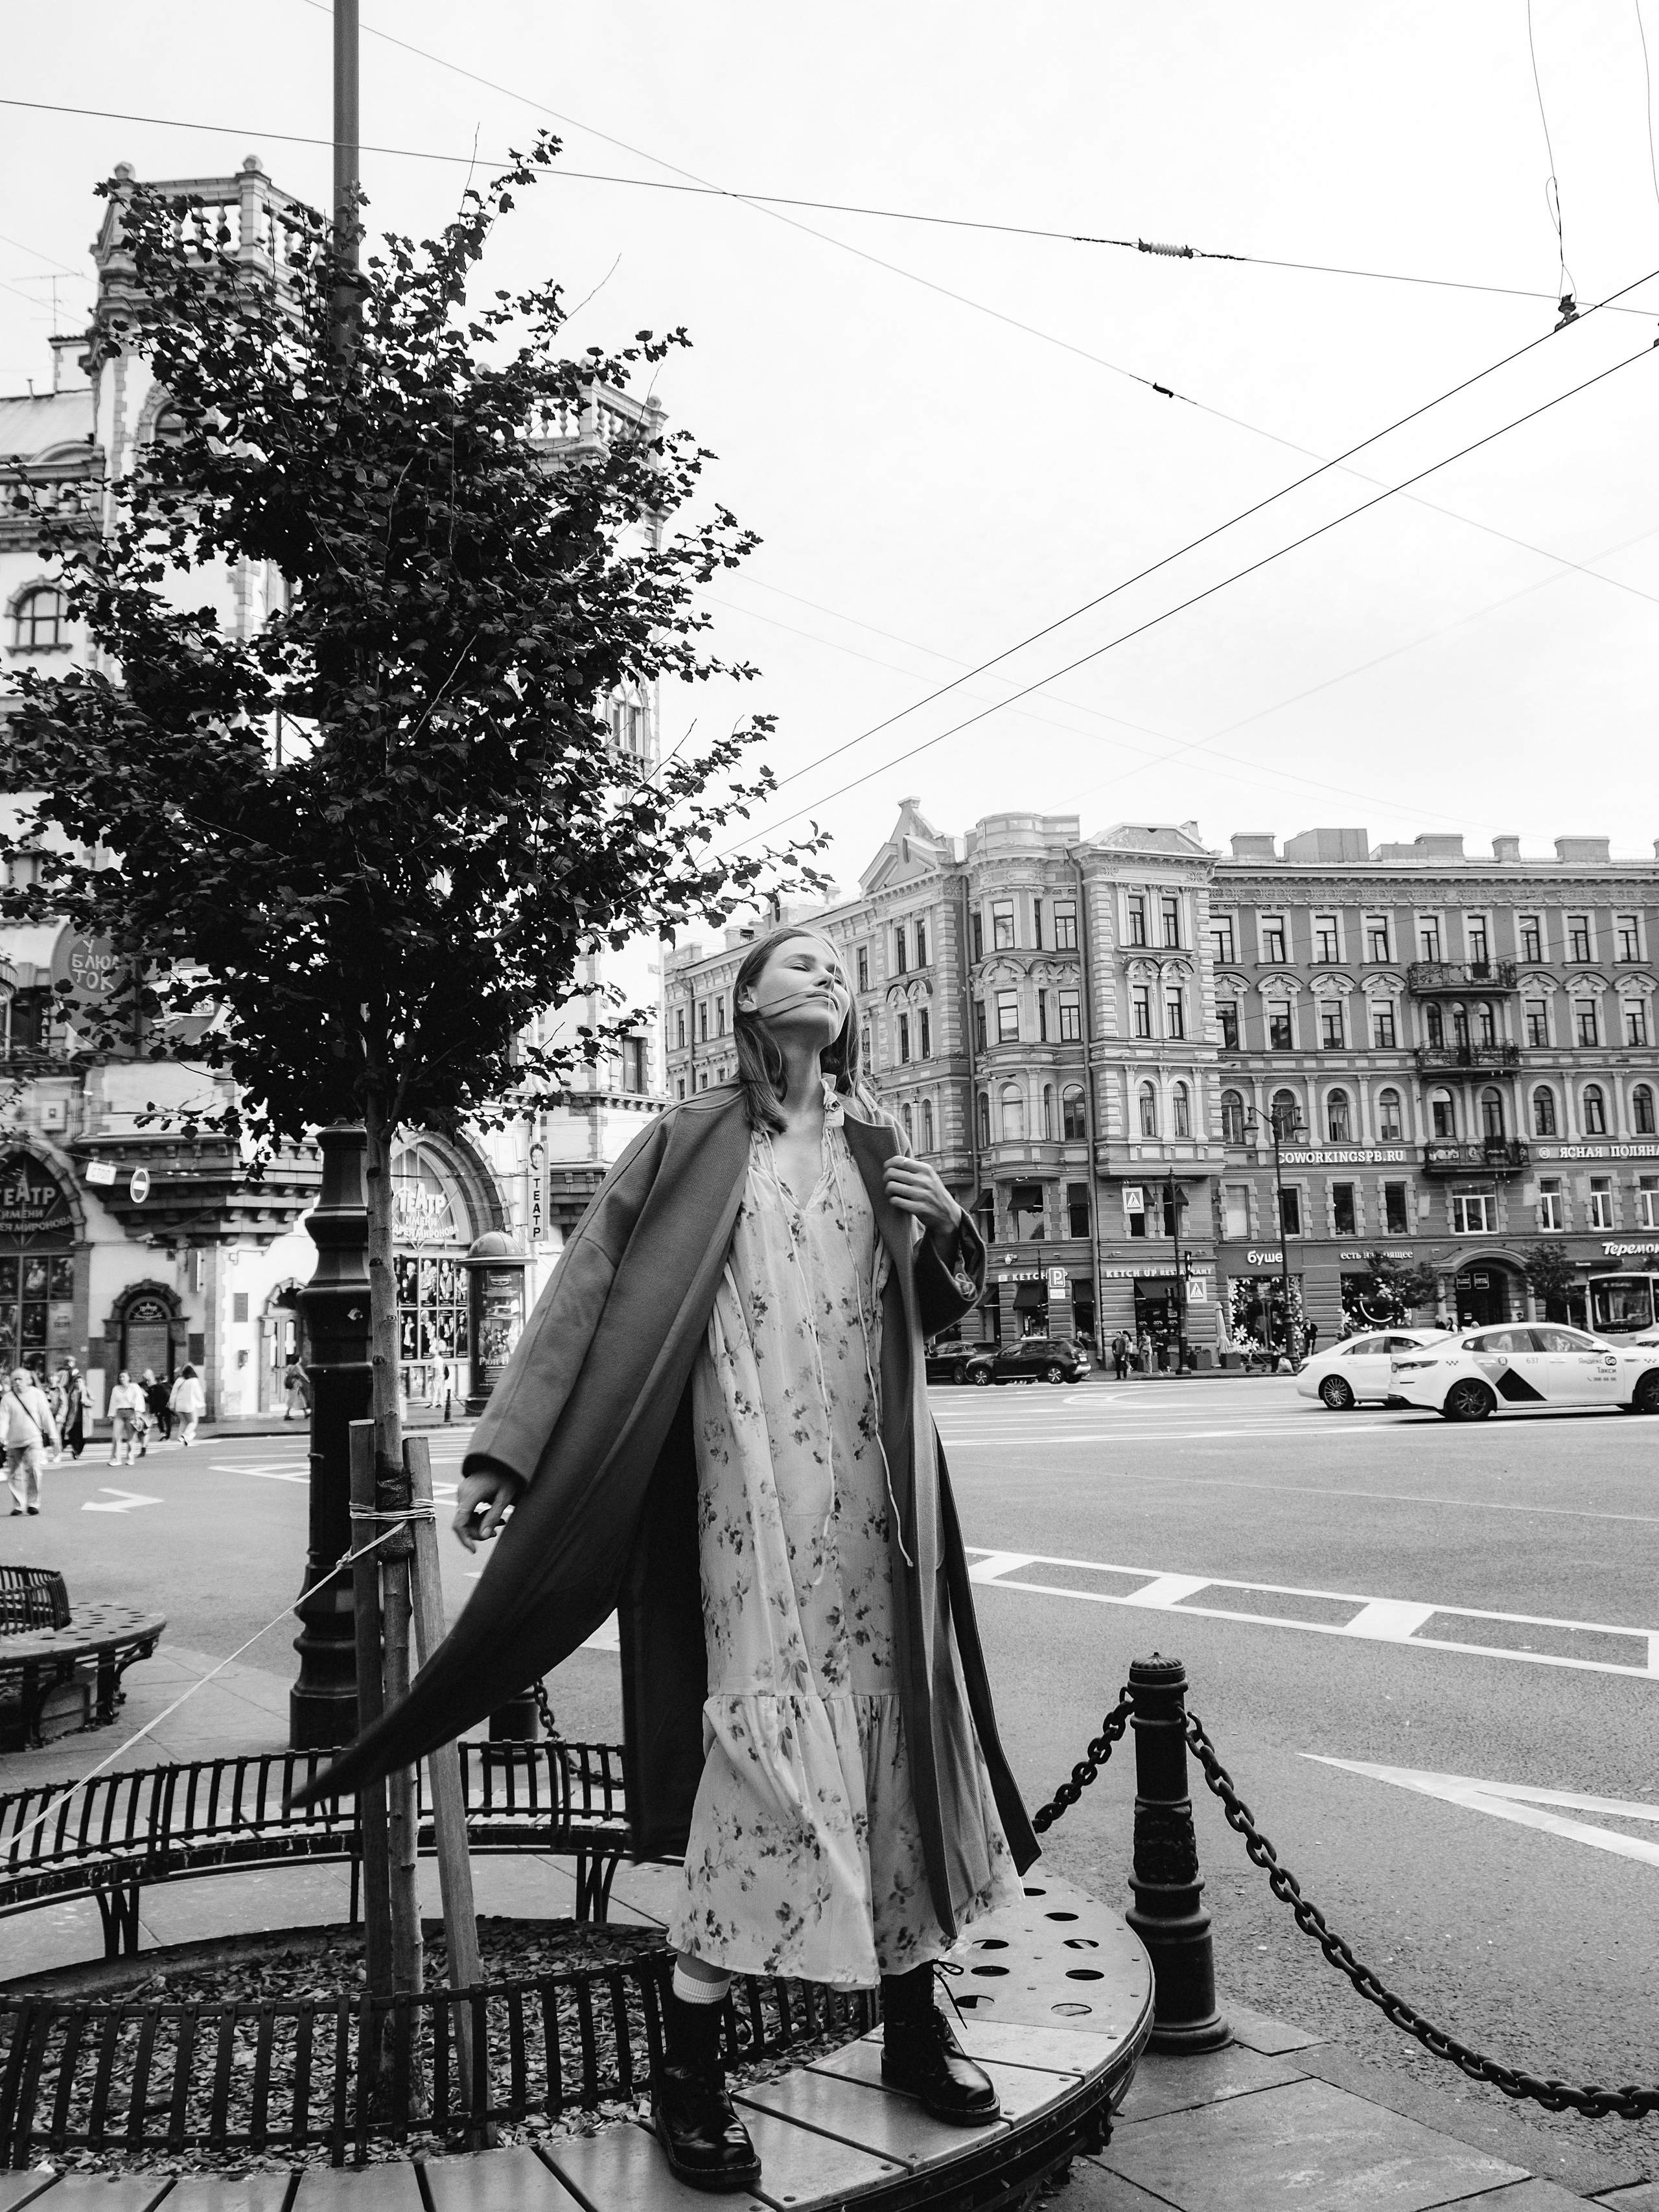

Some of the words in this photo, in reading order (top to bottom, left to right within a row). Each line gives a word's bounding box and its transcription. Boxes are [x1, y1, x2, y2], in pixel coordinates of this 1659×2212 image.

[83, 939, 95, 953] У
[72, 969, 114, 990] ТОК
[41, 1007, 49, 1048] SALE
[1279, 1150, 1405, 1164] COWORKINGSPB.RU
[1559, 1146, 1603, 1158] ЯСНАЯ
[91, 1167, 111, 1180] СТОП
[0, 1177, 56, 1206] ЕАТР
[398, 1183, 447, 1214] ТЕАТР
[1, 1209, 43, 1219] ИМЕНИ
[532, 1178, 541, 1238] ТЕАТР
[14, 1215, 72, 1232] МИРОНОВА
[406, 1216, 439, 1227] ИМЕНИ
[416, 1224, 459, 1239] МИРОНОВА
[1247, 1250, 1283, 1266] буше
[1340, 1252, 1362, 1260] есть
[1363, 1251, 1413, 1259] наоящее
[1143, 1268, 1157, 1277] UP
[1605, 1356, 1616, 1365] Go
